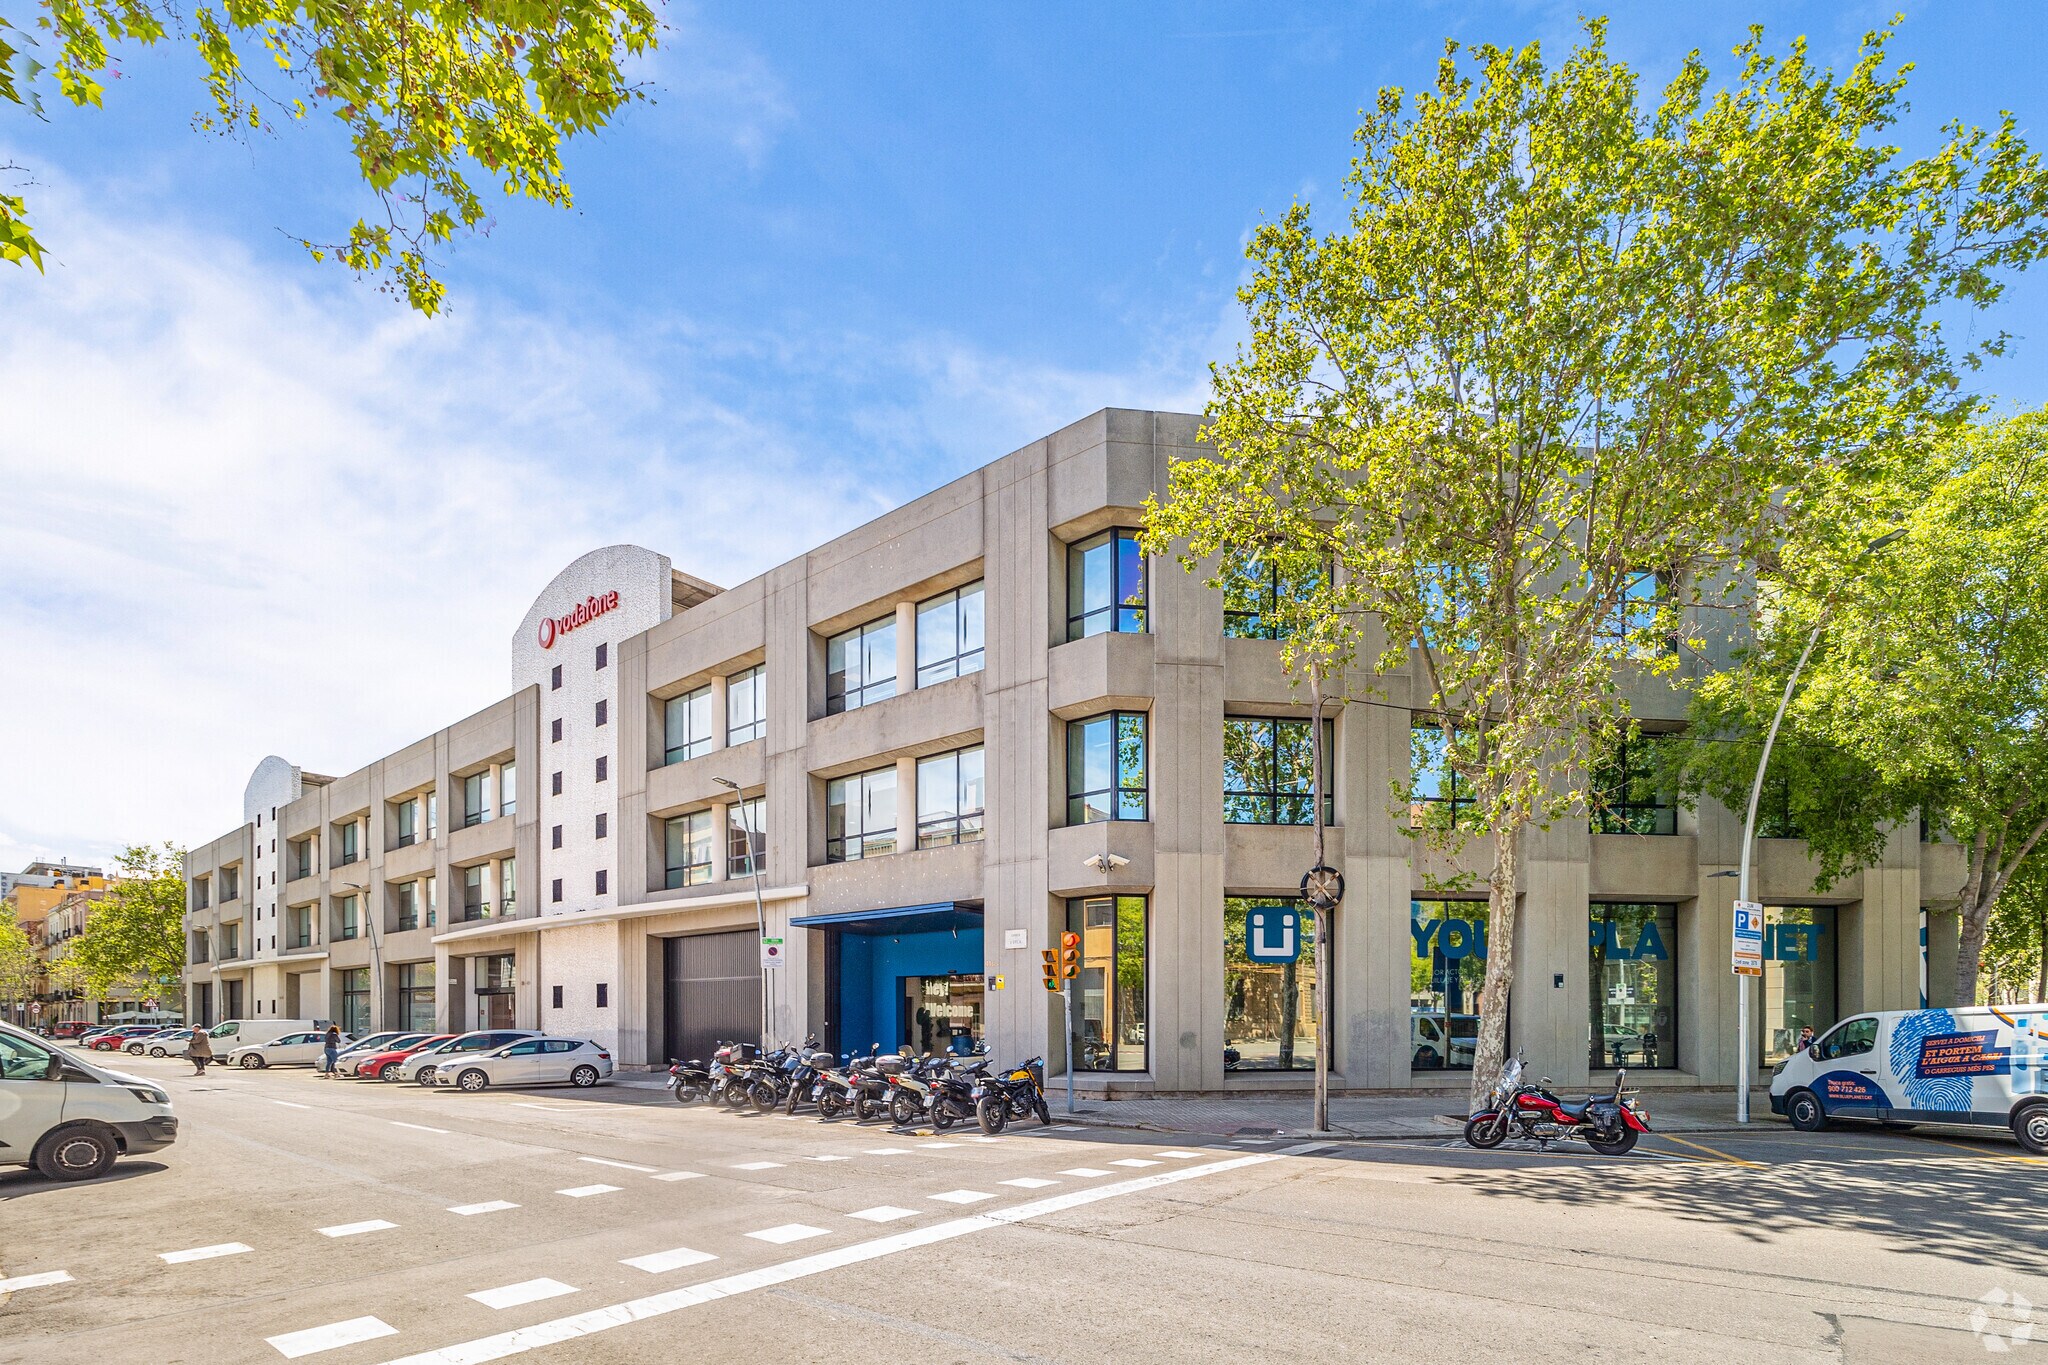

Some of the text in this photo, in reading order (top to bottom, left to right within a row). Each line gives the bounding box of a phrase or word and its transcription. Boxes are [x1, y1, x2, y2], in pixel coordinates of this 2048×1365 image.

[557, 590, 619, 635] vodafone
[1738, 913, 1746, 927] P
[1589, 921, 1669, 960] PLA
[924, 1002, 974, 1018] Welcome
[1925, 1046, 1983, 1057] ET PORTEM
[1922, 1056, 1960, 1065] L'AIGUA
